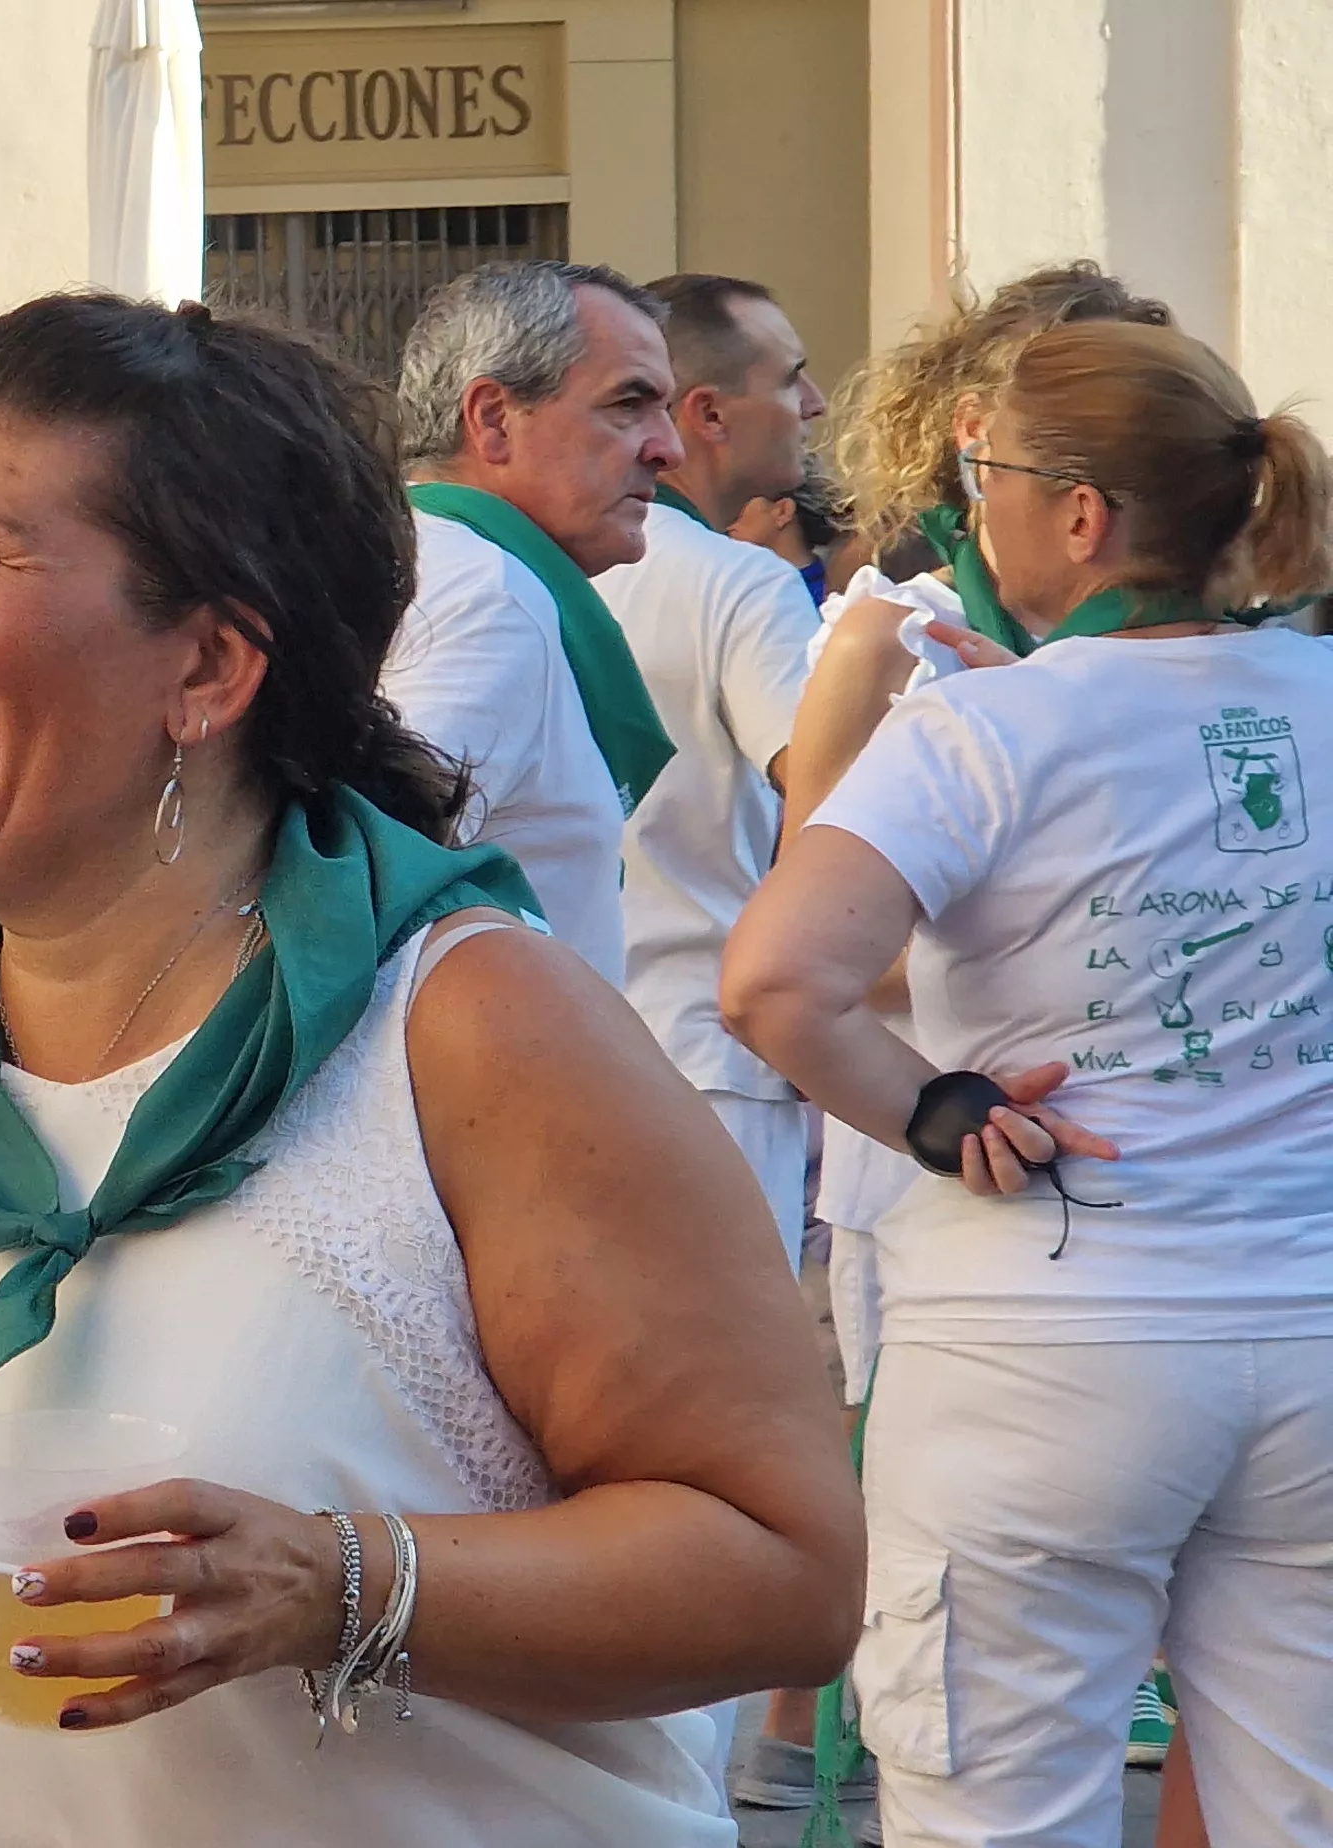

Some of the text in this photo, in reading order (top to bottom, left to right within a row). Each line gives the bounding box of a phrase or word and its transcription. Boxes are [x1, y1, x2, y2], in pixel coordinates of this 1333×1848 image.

[1199, 716, 1291, 741] OS FATICOS
[1090, 895, 1123, 917] EL
[1137, 887, 1248, 917] AROMA
[1260, 883, 1301, 910] DE
[1086, 946, 1131, 969] LA
[1087, 1000, 1121, 1020] EL
[1222, 1000, 1256, 1022] EN
